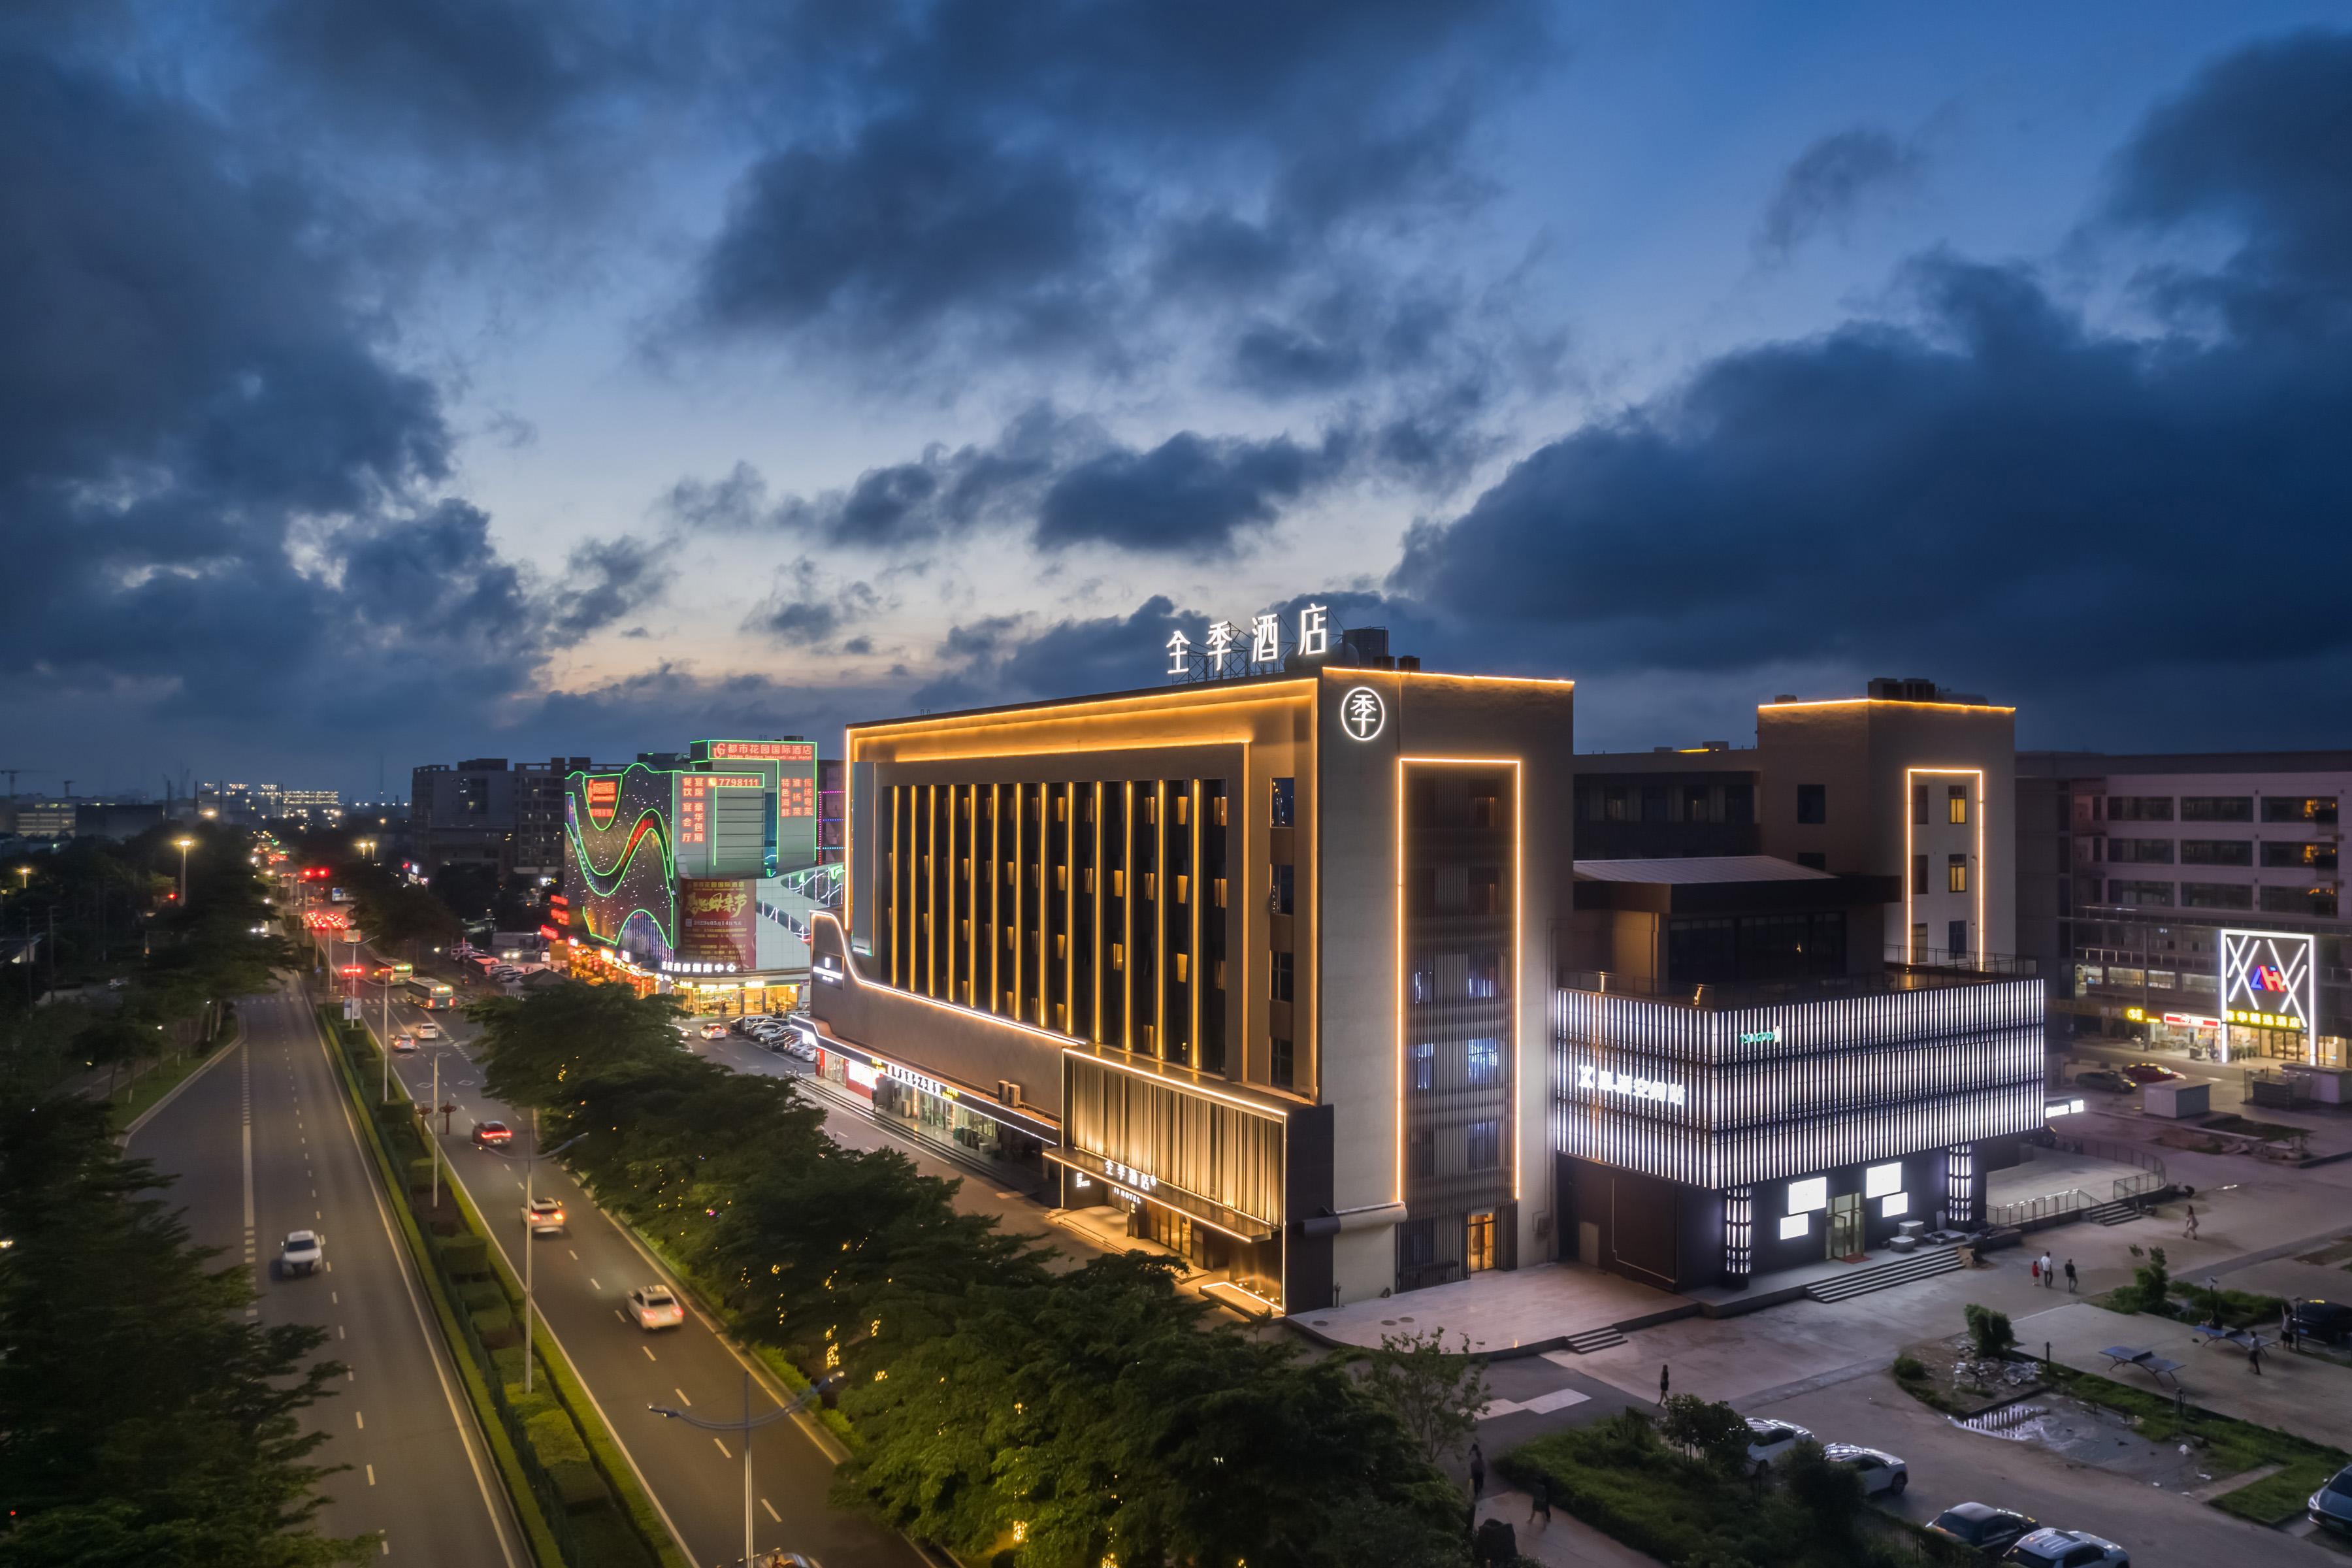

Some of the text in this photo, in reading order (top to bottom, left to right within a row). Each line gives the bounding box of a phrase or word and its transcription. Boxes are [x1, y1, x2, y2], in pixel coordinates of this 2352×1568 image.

[1166, 603, 1328, 674] 全季酒店
[1350, 694, 1377, 737] 季
[728, 743, 813, 755] 都市花园国际酒店
[1105, 1159, 1150, 1191] 全季酒店
